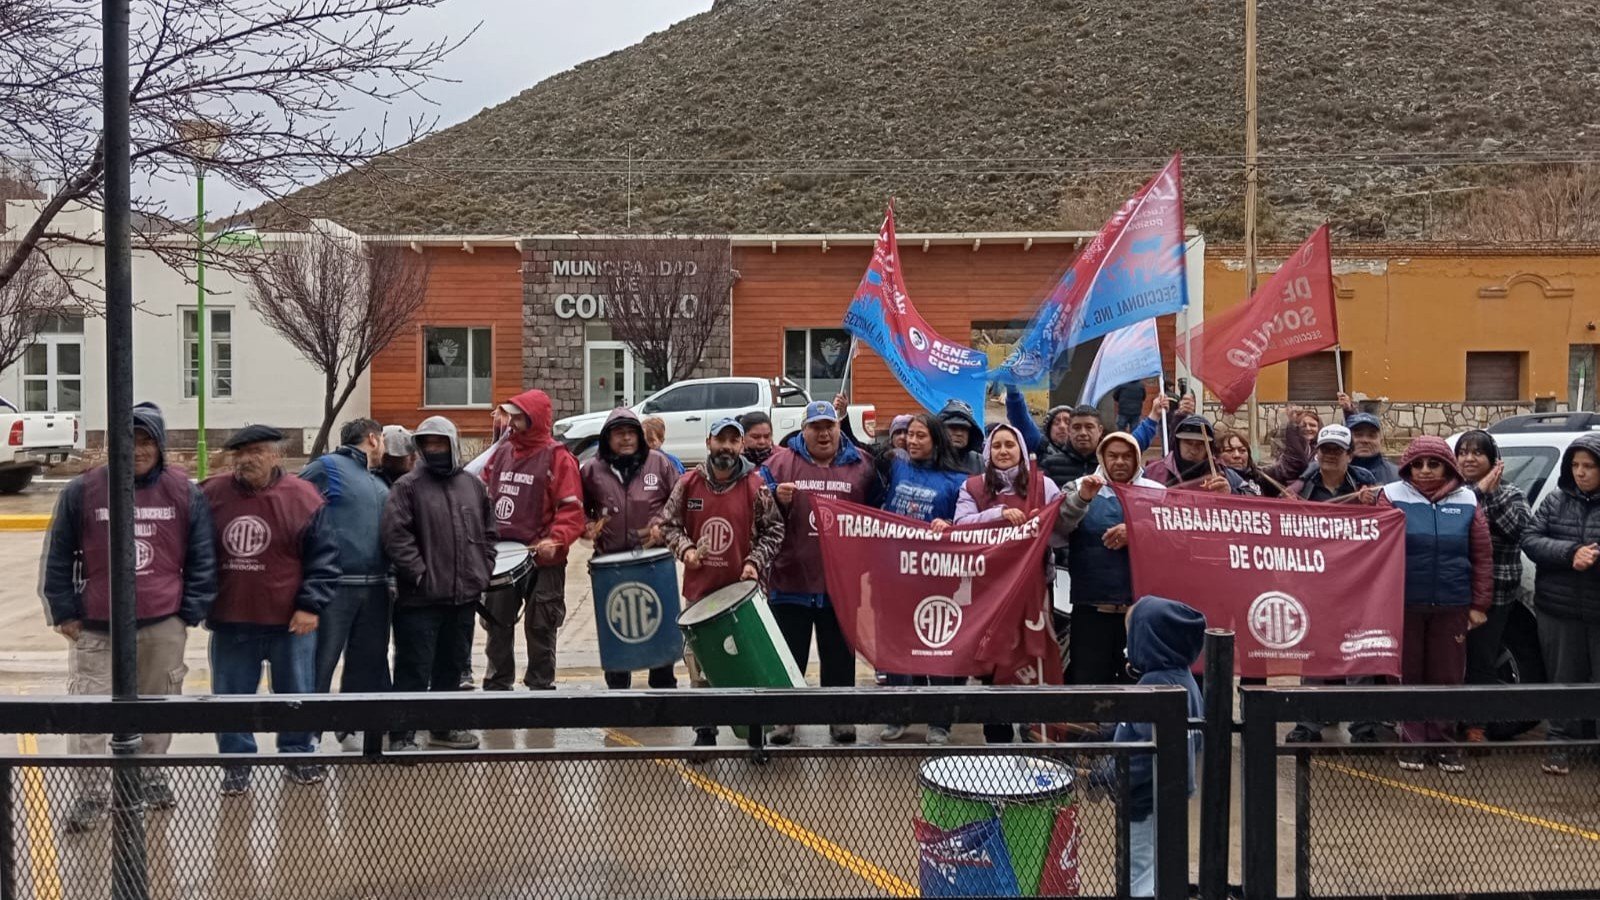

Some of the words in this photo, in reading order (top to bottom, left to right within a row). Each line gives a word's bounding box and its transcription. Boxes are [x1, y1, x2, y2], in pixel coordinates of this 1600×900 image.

[615, 277, 640, 292] DE
[930, 349, 982, 367] SALAMANCA
[933, 340, 970, 359] RENE
[928, 355, 960, 375] CCC
[1151, 506, 1272, 536] TRABAJADORES
[1279, 513, 1380, 541] MUNICIPALES
[900, 550, 918, 575] DE
[921, 552, 986, 577] COMALLO
[1229, 545, 1250, 569] DE
[1253, 546, 1325, 573] COMALLO
[609, 585, 659, 640] ATE
[917, 598, 960, 645] ATE
[1252, 596, 1304, 647] ATE
